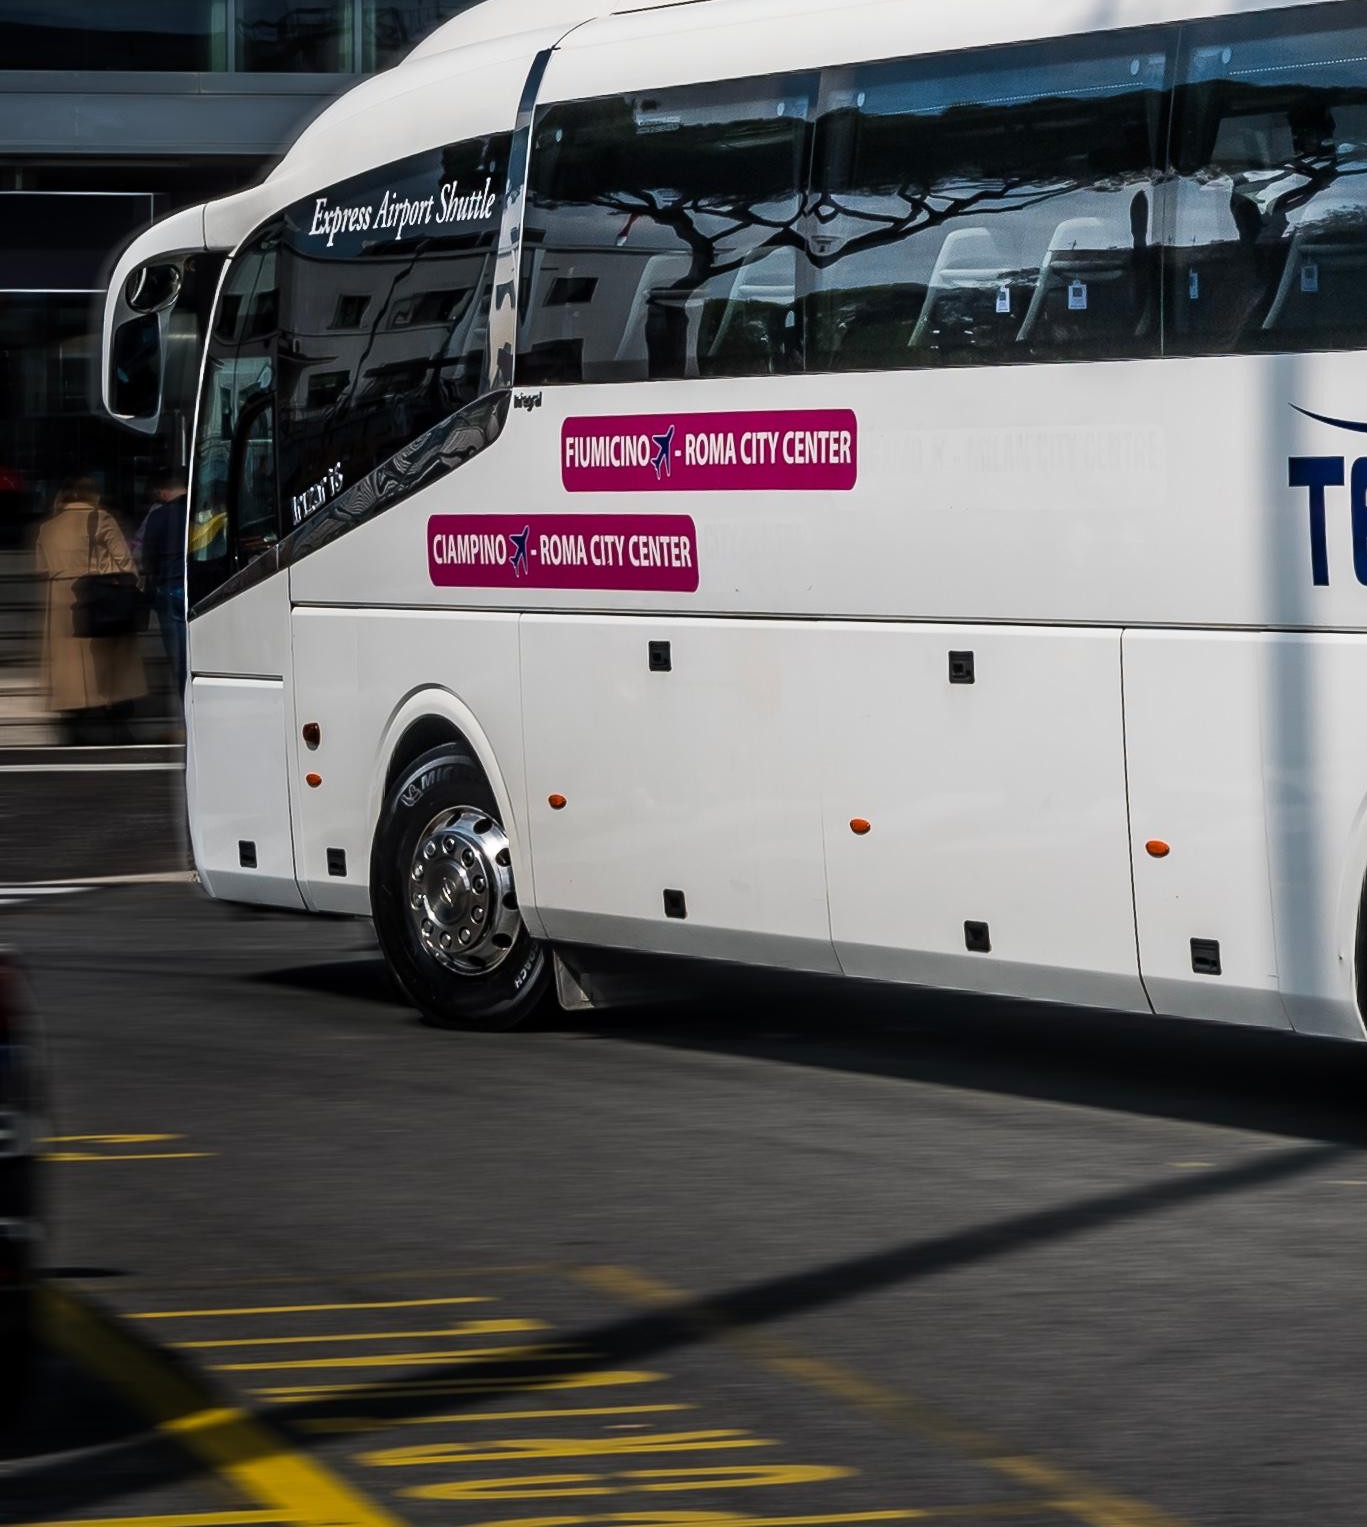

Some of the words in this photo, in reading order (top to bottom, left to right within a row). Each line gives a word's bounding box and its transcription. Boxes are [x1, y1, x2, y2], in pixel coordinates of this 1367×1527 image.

[308, 197, 374, 248] Express
[372, 190, 435, 241] Airport
[435, 176, 496, 224] Shuttle
[565, 434, 650, 469] FIUMICINO
[684, 432, 738, 465] ROMA
[740, 431, 780, 465] CITY
[782, 430, 852, 464] CENTER
[432, 533, 508, 565] CIAMPINO
[540, 534, 589, 566] ROMA
[589, 534, 626, 567] CITY
[628, 534, 693, 568] CENTER
